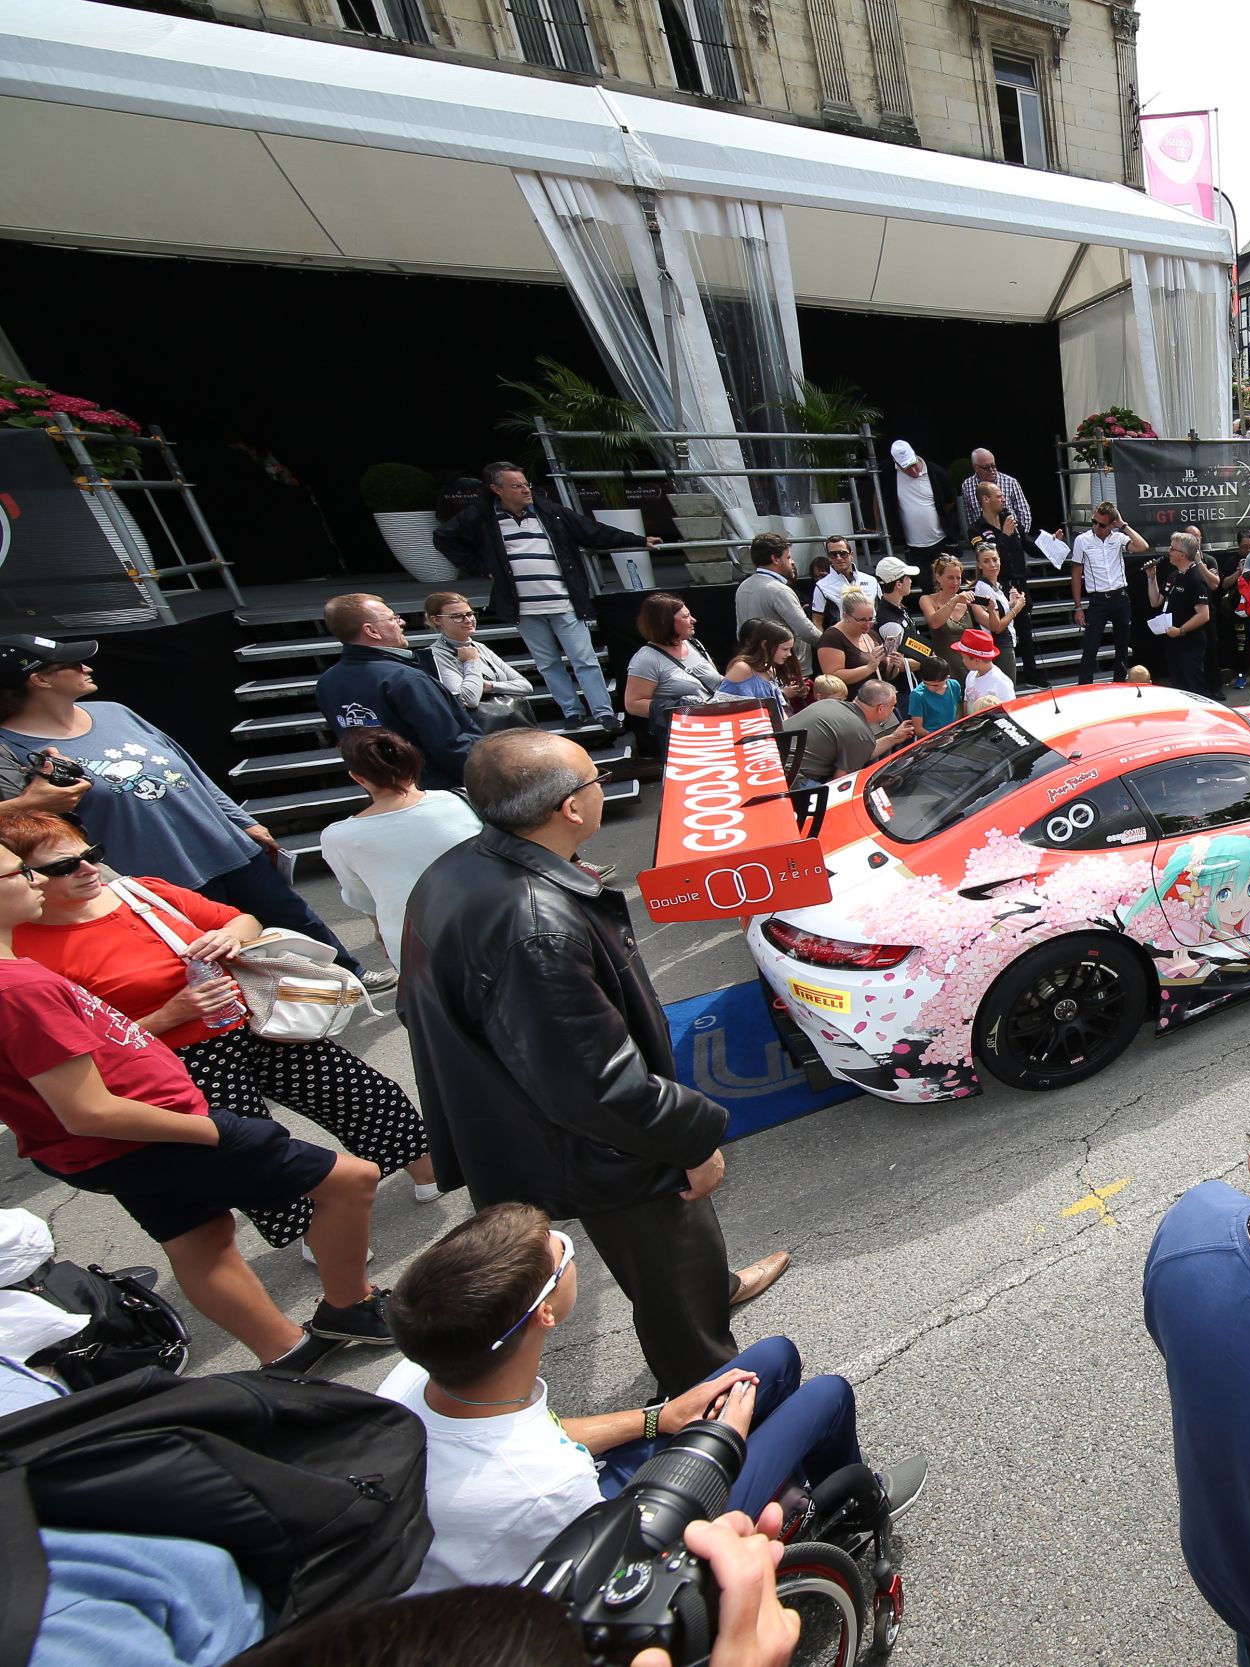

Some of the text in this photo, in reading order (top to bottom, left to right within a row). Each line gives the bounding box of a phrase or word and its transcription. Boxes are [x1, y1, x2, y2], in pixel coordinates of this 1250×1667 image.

[1138, 481, 1239, 499] BLANCPAIN
[1156, 507, 1226, 524] GT SERIES
[739, 718, 787, 786] COMPNY
[650, 891, 701, 910] Double
[779, 866, 822, 882] Zero
[793, 983, 844, 1010] PIRELLI
